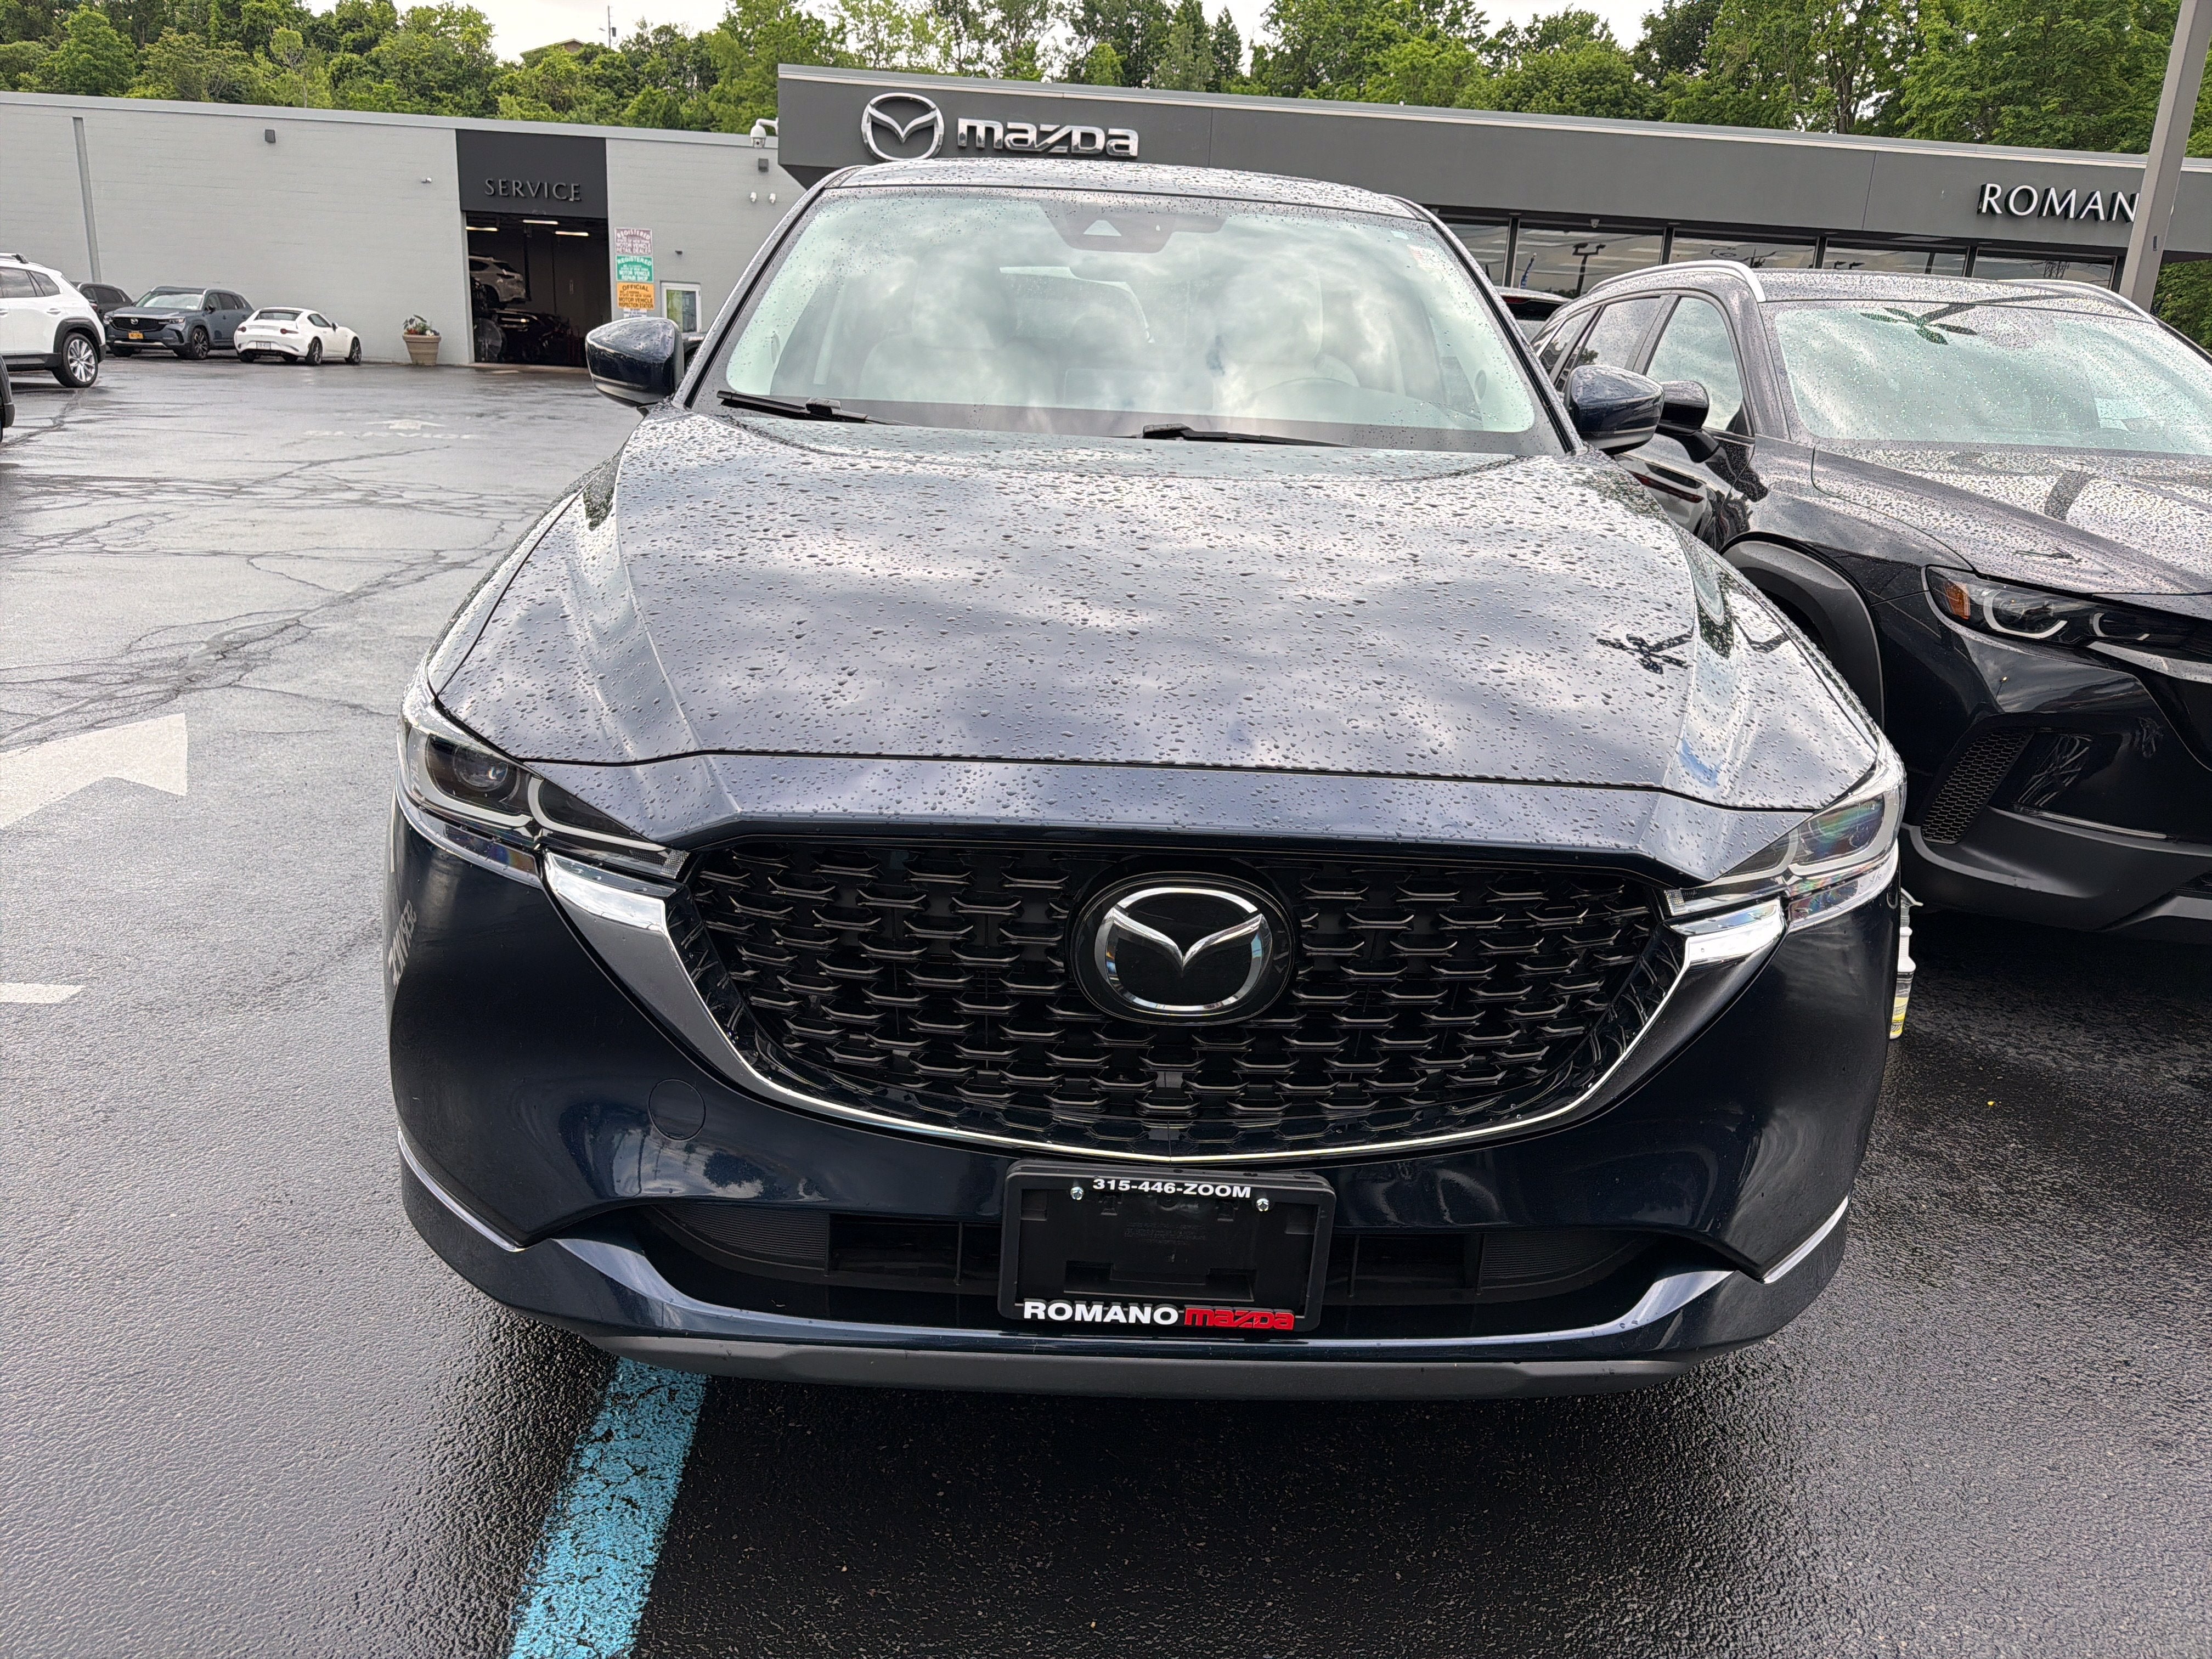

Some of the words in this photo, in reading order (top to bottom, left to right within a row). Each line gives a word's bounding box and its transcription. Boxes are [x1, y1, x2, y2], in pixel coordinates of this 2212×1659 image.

[957, 117, 1139, 157] mazda
[485, 178, 581, 201] SERVICE
[1977, 183, 2174, 223] ROMAN
[617, 229, 651, 240] REGISTERED
[617, 256, 651, 266] REGISTERED
[1092, 1178, 1251, 1199] 315-446-ZOOM
[1024, 1301, 1178, 1325] ROMANO
[1184, 1307, 1295, 1331] mazda
